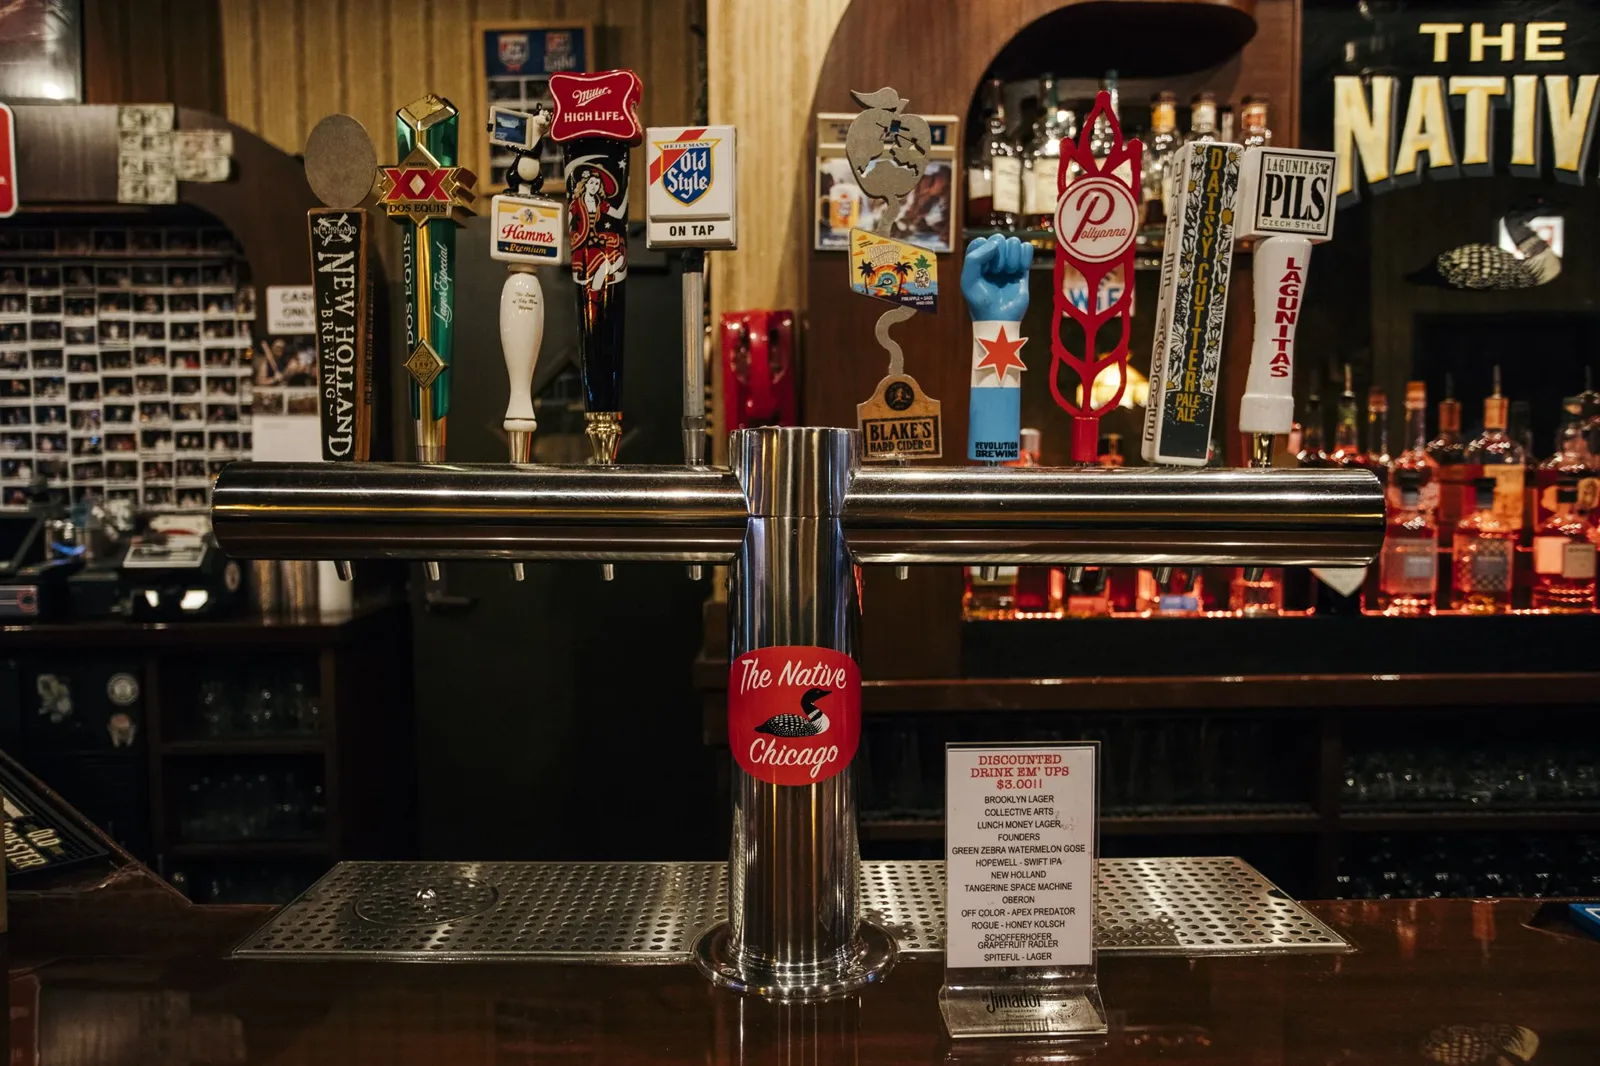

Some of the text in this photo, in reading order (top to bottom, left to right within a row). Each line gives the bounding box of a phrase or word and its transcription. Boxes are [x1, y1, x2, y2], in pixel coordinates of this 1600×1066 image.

[1418, 22, 1568, 62] THE
[572, 87, 609, 106] Miller
[564, 110, 619, 122] HIGH LIFE
[680, 151, 706, 172] Old
[1267, 158, 1320, 175] LAGUNITAS
[667, 166, 707, 199] Style
[1262, 174, 1327, 222] PILS
[389, 204, 447, 213] DOS EQUIS
[1070, 187, 1127, 243] Pollyanna
[502, 223, 555, 243] Hamm's
[669, 225, 715, 236] ON TAP
[508, 243, 547, 255] Premium
[403, 232, 412, 296] EQUIS
[1184, 148, 1223, 392] DAISY CUTTER
[434, 240, 452, 328] Lager Especial
[1269, 257, 1302, 378] LAGUNITAS
[318, 251, 355, 457] NEW HOLLAND
[321, 309, 336, 399] BREWING
[1176, 394, 1201, 408] PALE
[1176, 408, 1196, 422] ALE
[870, 421, 932, 441] BLAKE'S
[870, 441, 894, 452] HARD
[896, 440, 923, 450] CIDER
[975, 441, 1018, 449] REVOLUTION
[740, 658, 847, 695] The Native
[750, 738, 838, 778] Chicago
[978, 754, 1062, 766] DISCOUNTED
[970, 766, 1069, 778] DRINK EM' UPS
[1028, 795, 1054, 803] LAGER
[984, 808, 1031, 816] COLLECTIVE
[977, 821, 1004, 829] LUNCH
[27, 828, 61, 847] OLD
[1008, 846, 1062, 854] WATERMELON
[1064, 845, 1085, 853] GOSE
[1011, 871, 1046, 879] HOLLAND
[1037, 882, 1072, 890] MACHINE
[978, 941, 1026, 949] GRAPEFRUIT
[984, 933, 1052, 941] SCHOFFERHOFER
[986, 990, 1042, 1013] Jimador
